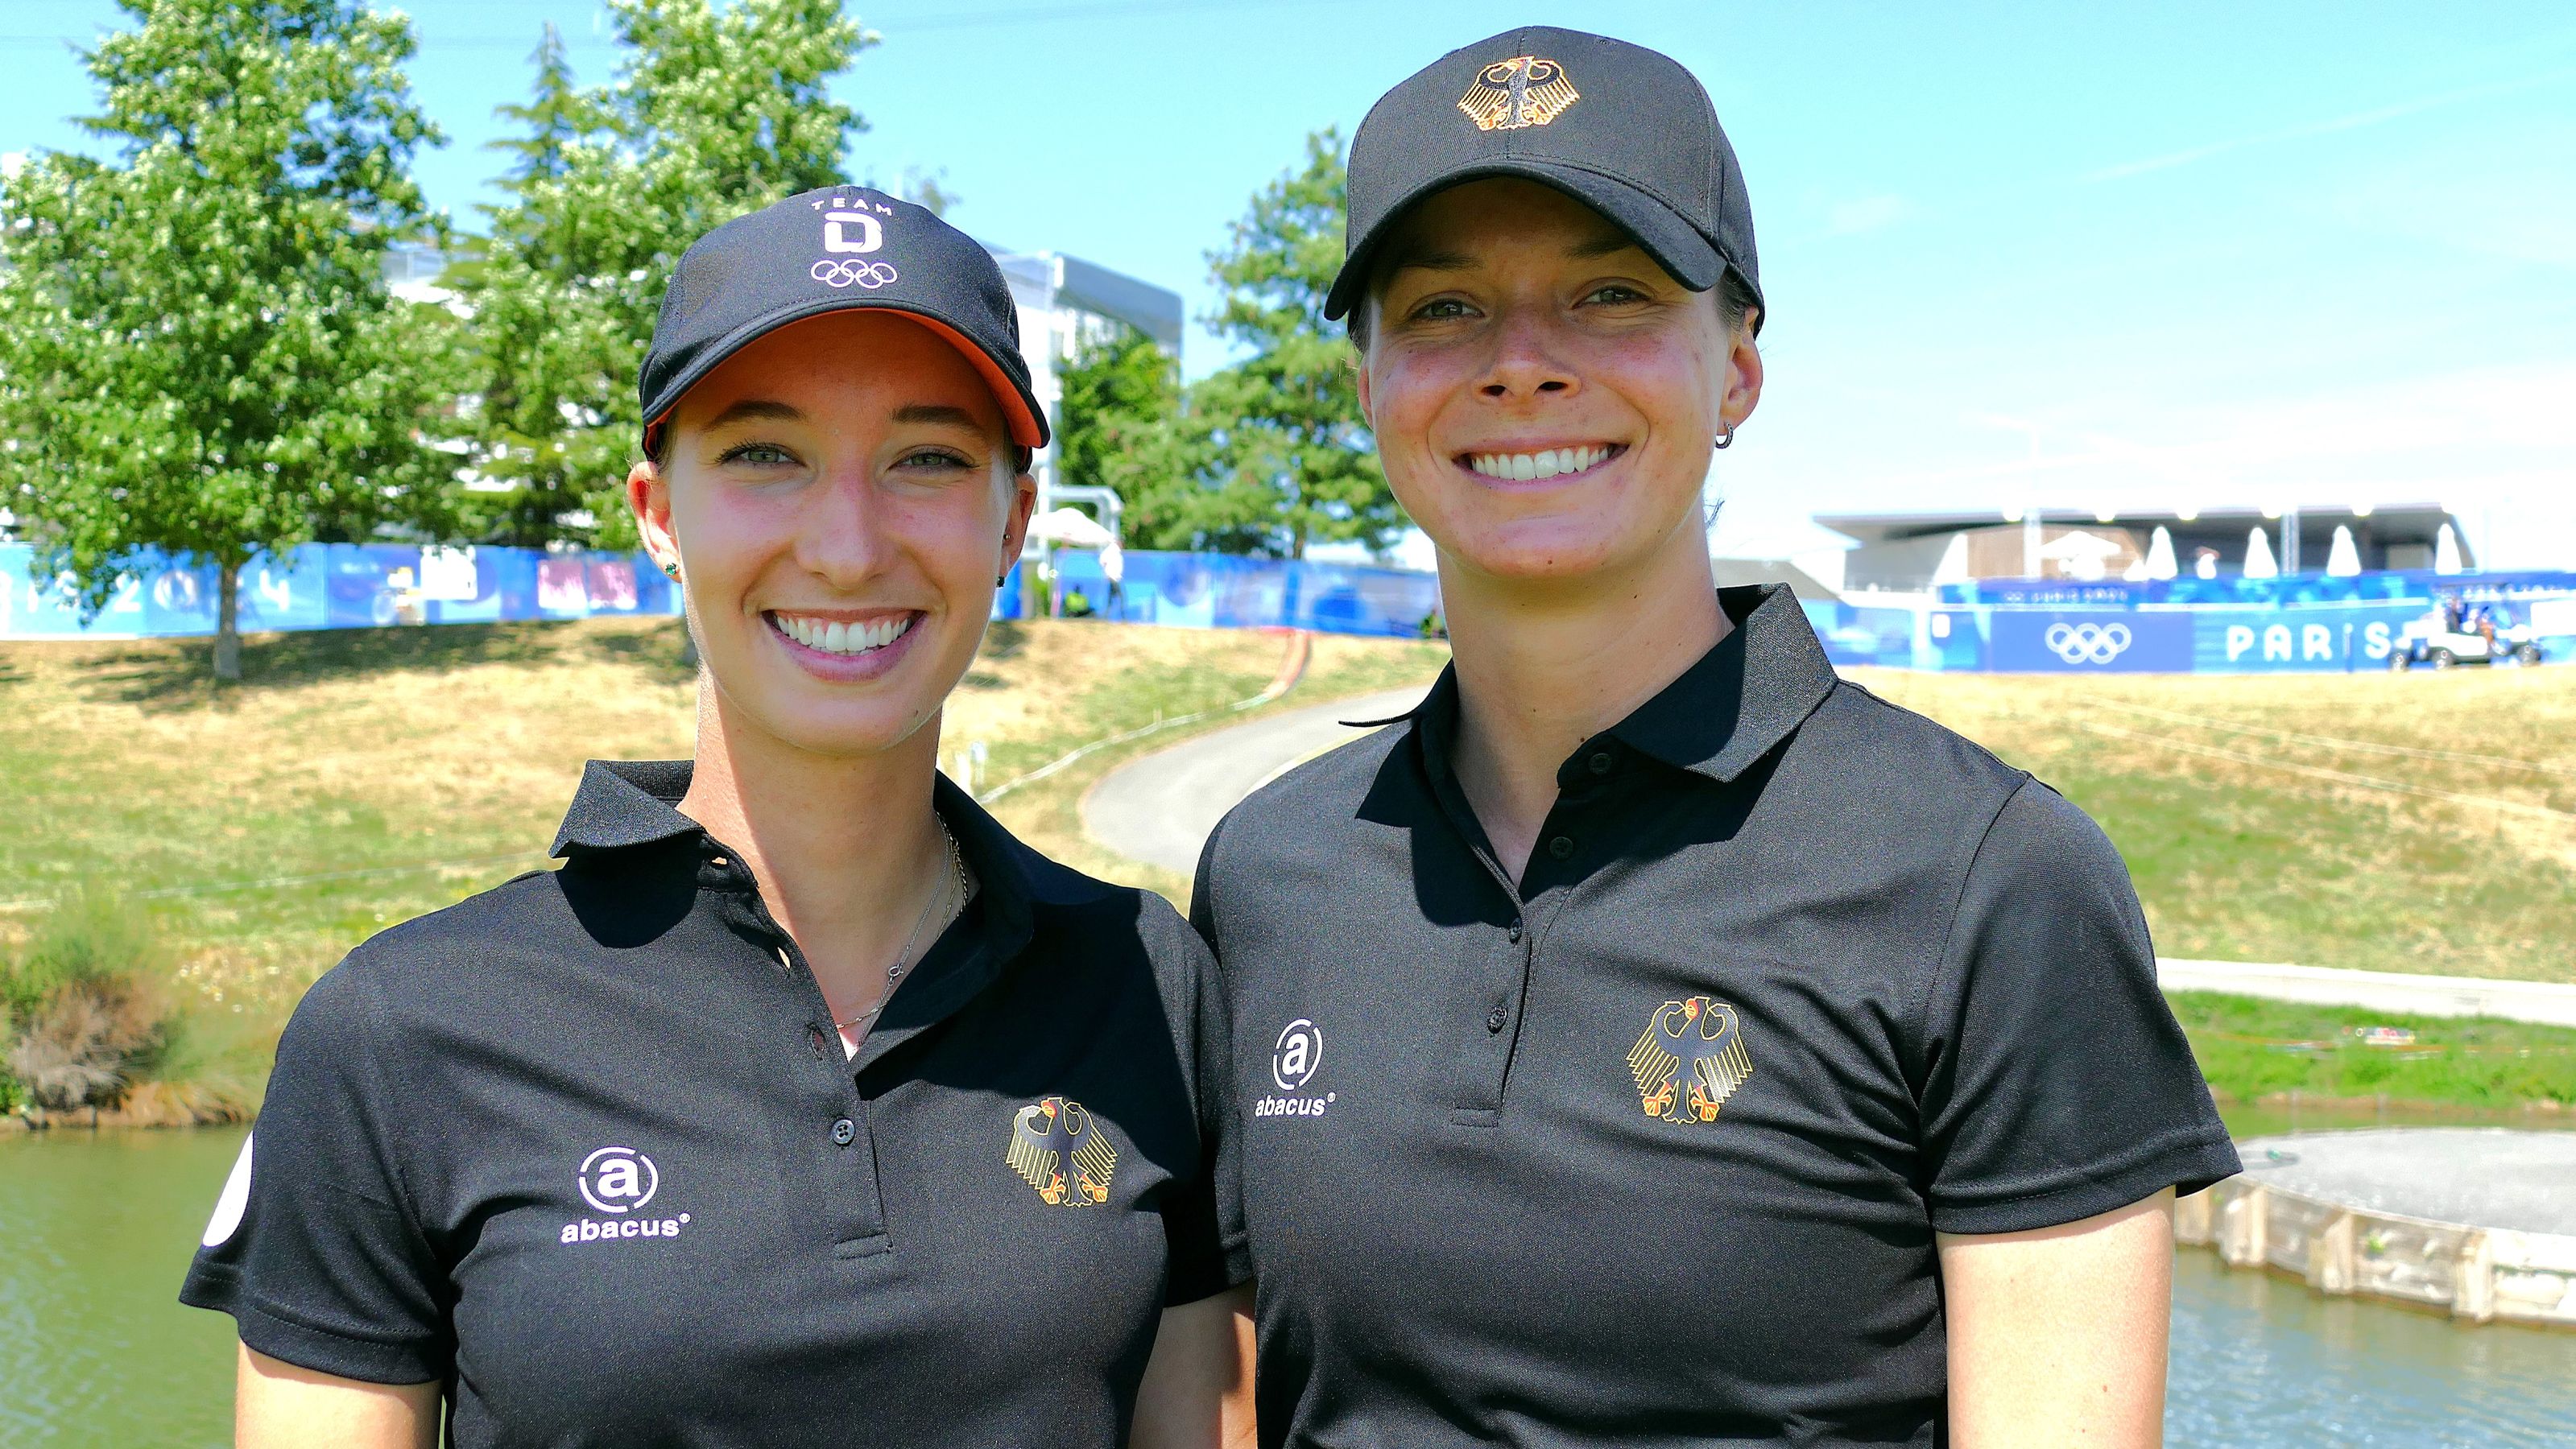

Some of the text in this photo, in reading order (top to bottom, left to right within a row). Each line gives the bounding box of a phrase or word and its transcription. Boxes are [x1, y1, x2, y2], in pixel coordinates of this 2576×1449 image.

[811, 197, 892, 217] TEAM
[824, 212, 883, 253] D
[113, 568, 291, 613] 204
